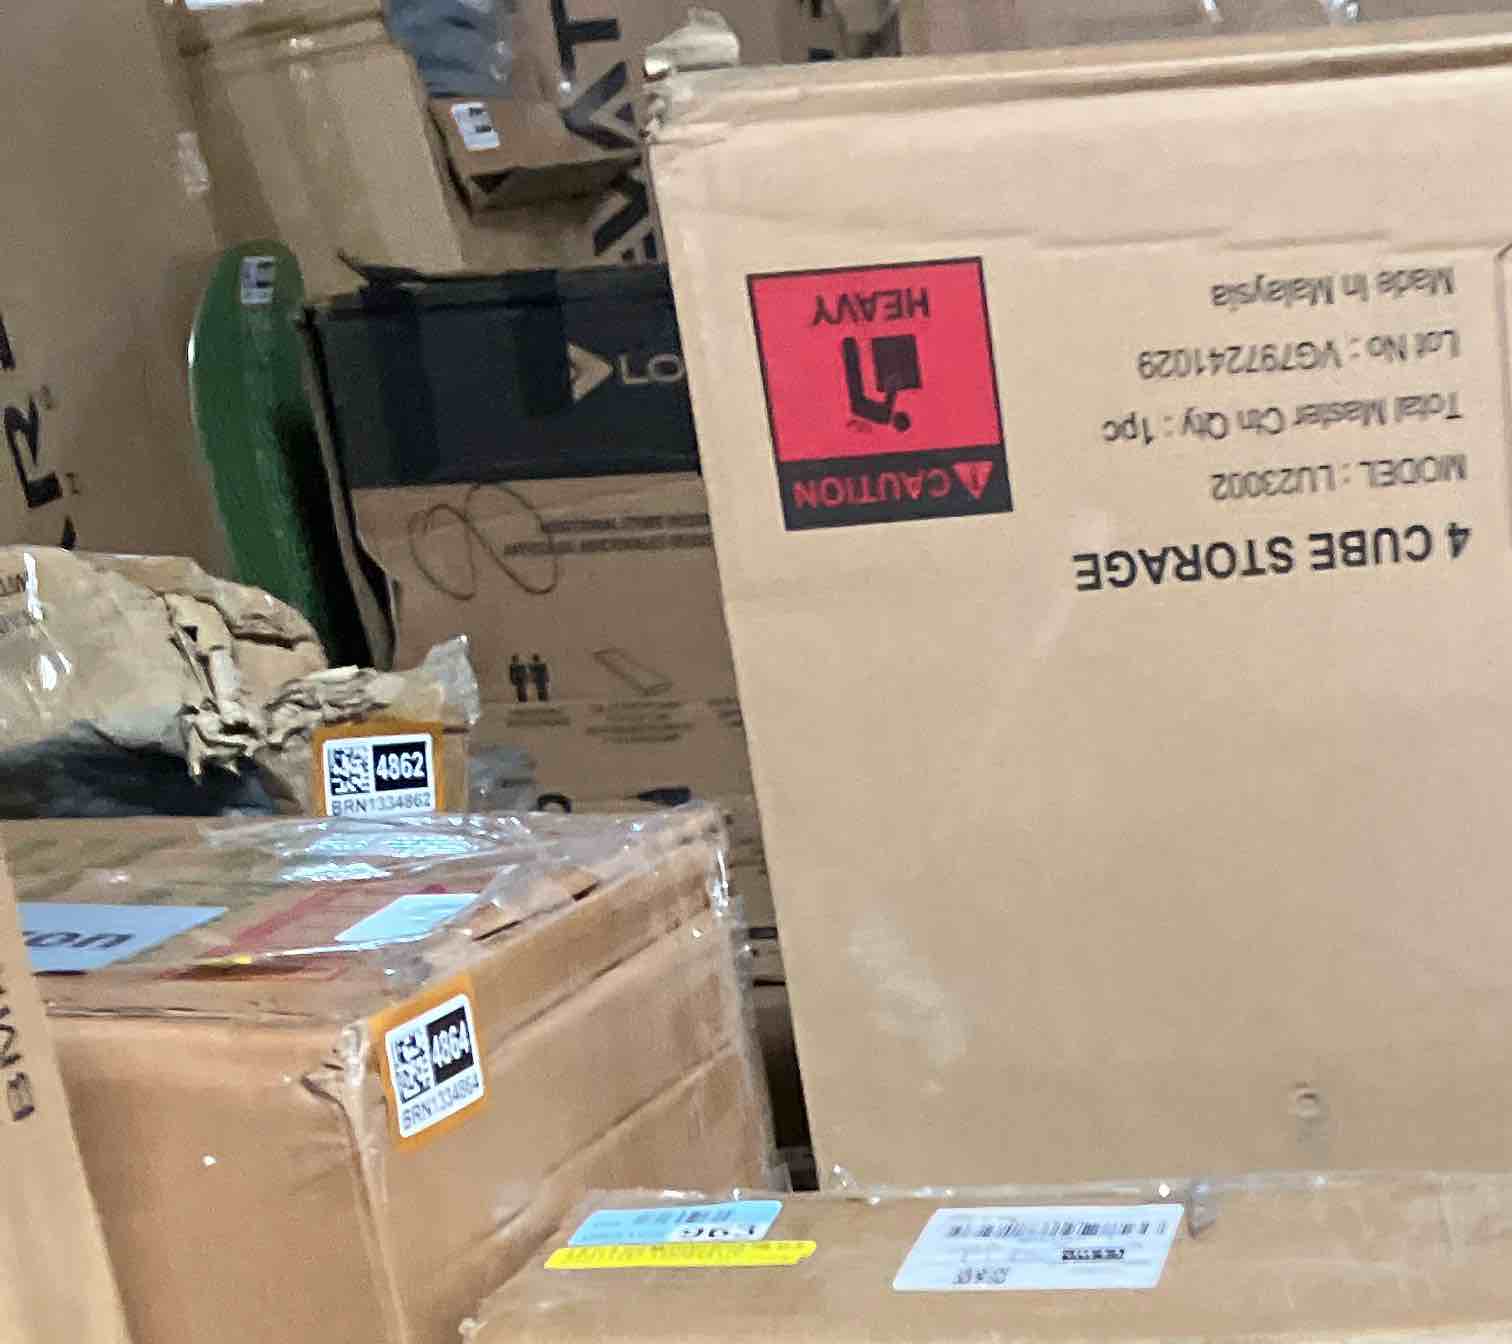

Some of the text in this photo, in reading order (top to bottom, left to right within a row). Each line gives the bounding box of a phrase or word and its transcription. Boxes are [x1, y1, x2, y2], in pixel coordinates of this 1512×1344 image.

[1211, 273, 1334, 308] Malaysia
[1374, 266, 1455, 299] Made
[810, 287, 931, 327] HEAVY
[1137, 339, 1342, 380] VG797241029
[1416, 328, 1461, 360] Lot
[1181, 406, 1231, 440] Qty
[1237, 405, 1286, 435] Ctn
[1293, 398, 1388, 429] Master
[1394, 391, 1463, 423] Total
[1102, 412, 1155, 445] 1pc
[1210, 464, 1336, 500] LU23002
[1360, 453, 1467, 488] MODEL
[792, 469, 950, 509] CAUTION
[1072, 520, 1471, 591] 4 CUBE STORAGE
[376, 751, 425, 780] 4862
[432, 1019, 470, 1069] 4864
